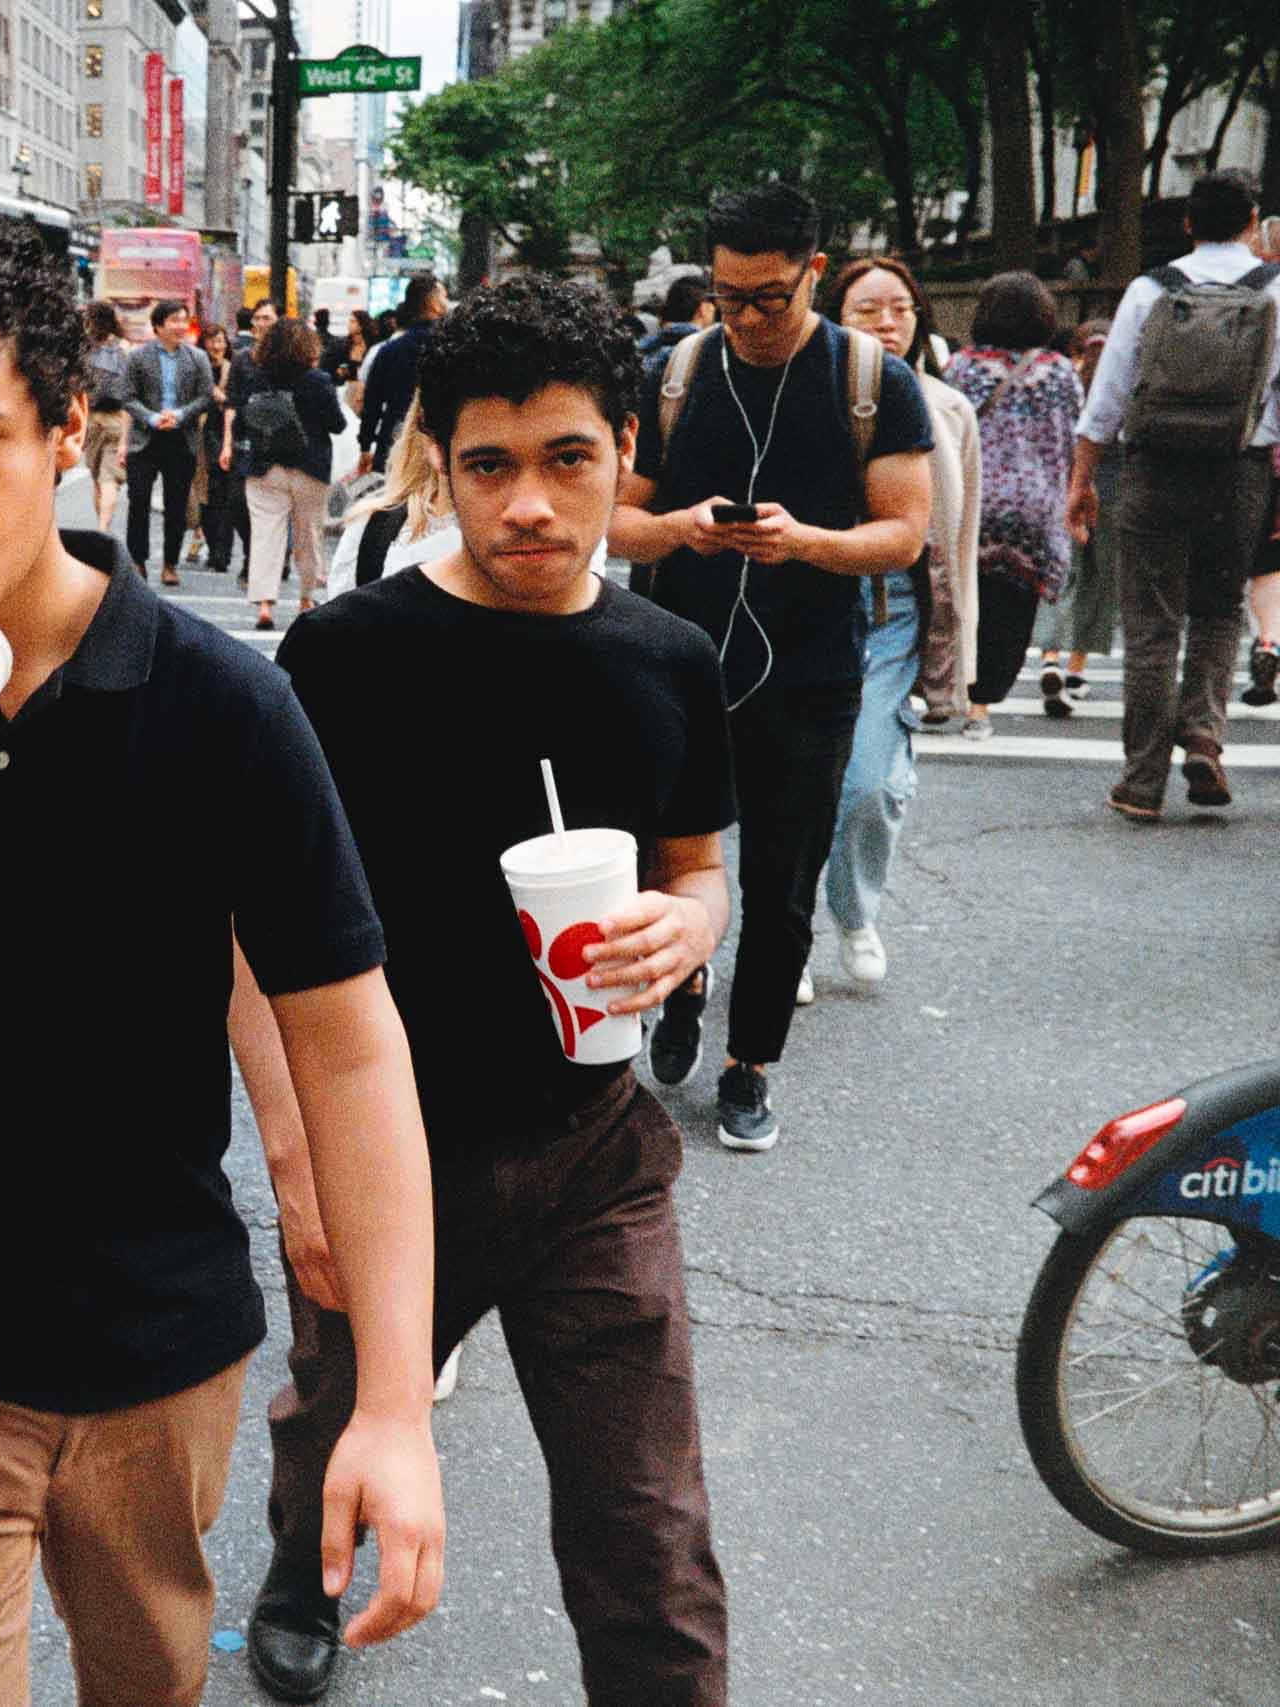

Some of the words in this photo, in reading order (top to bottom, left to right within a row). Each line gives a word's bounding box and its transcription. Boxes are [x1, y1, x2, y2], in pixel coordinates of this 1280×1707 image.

[304, 66, 351, 87] West
[355, 63, 391, 86] 42nd
[394, 64, 415, 85] St
[1180, 1160, 1240, 1198] citi
